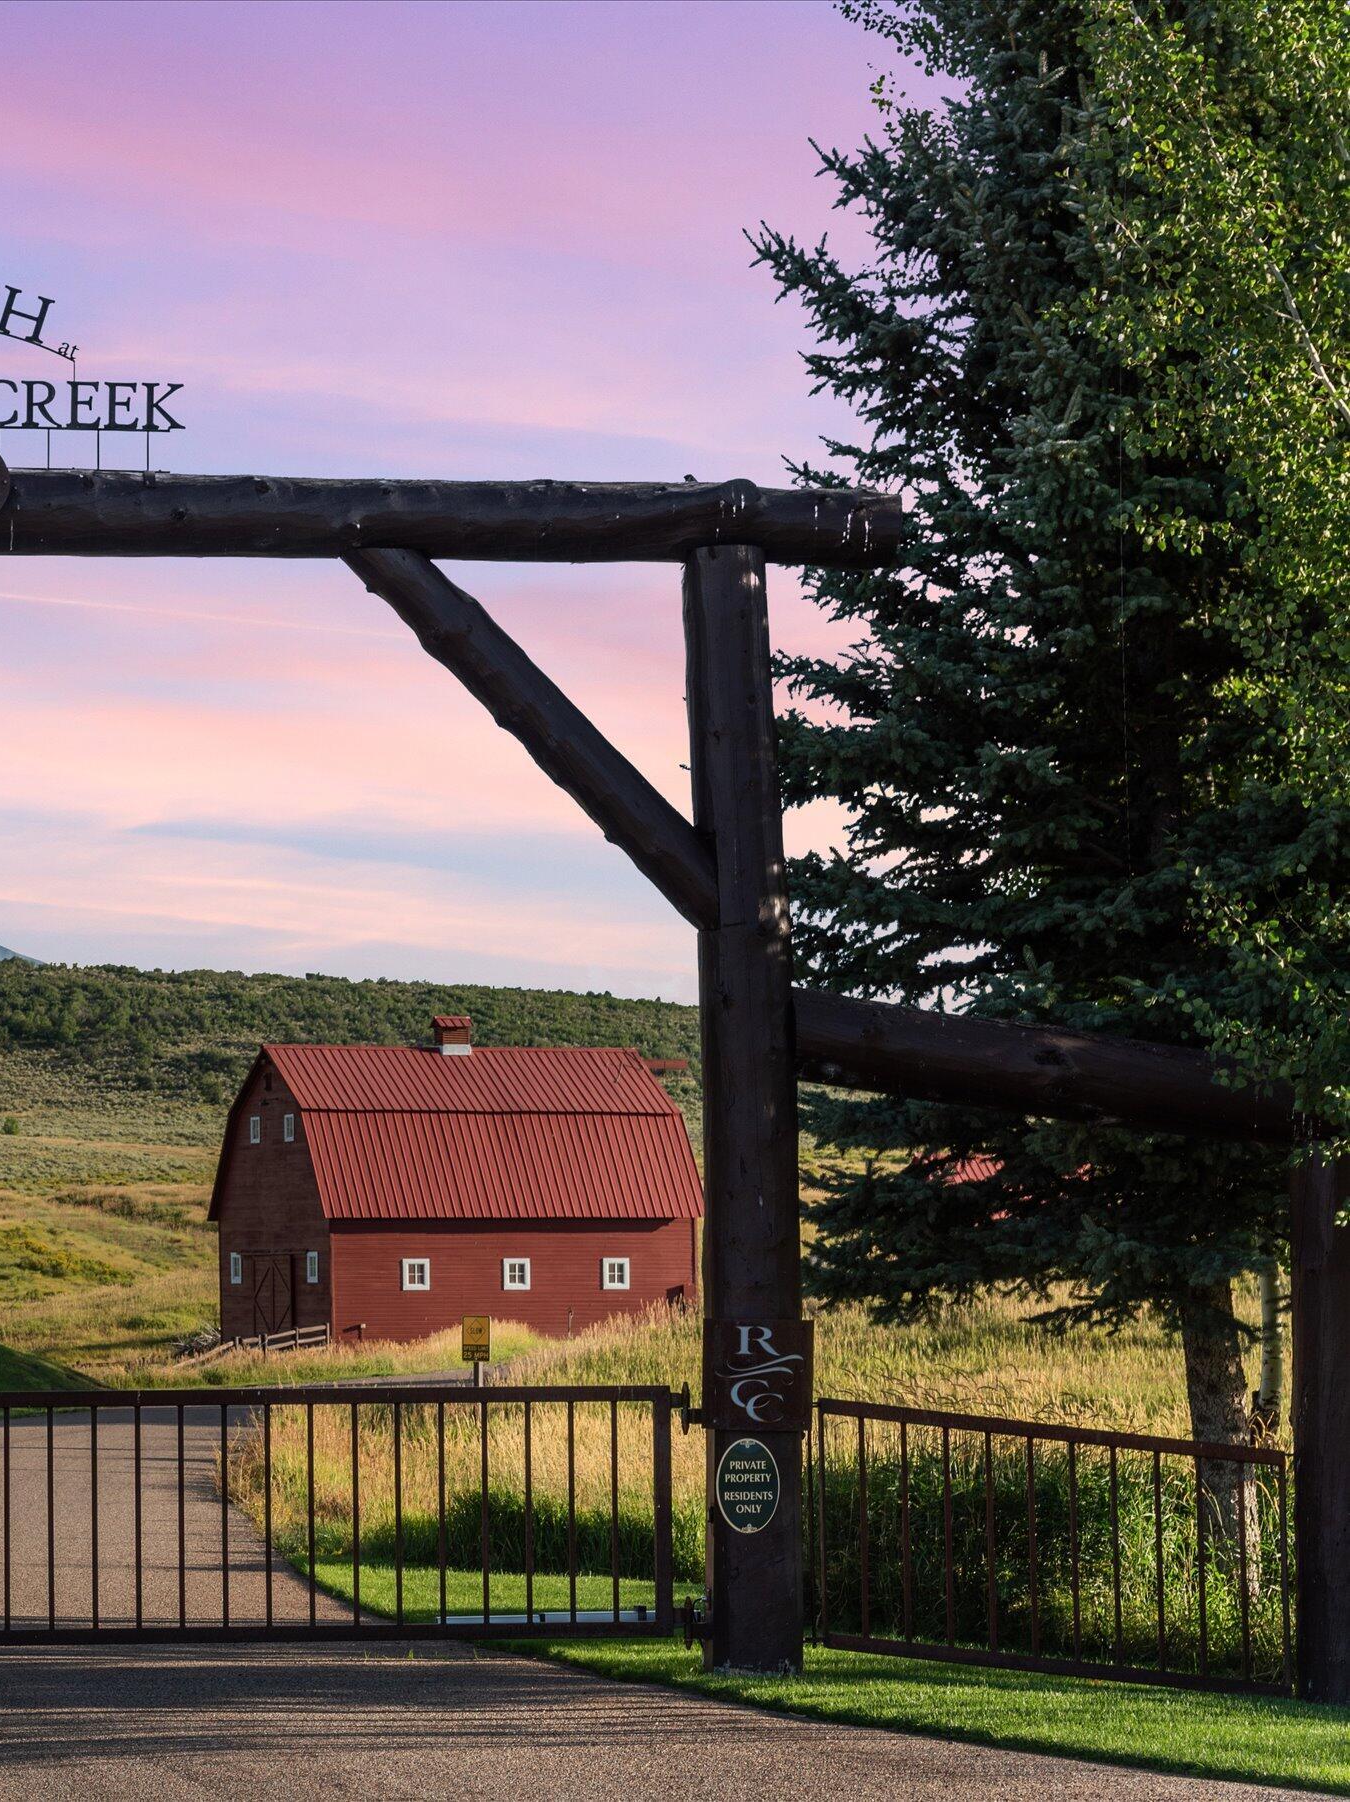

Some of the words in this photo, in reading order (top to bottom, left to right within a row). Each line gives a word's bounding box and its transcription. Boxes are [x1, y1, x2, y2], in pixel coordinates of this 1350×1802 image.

[57, 338, 81, 362] at
[735, 1325, 781, 1357] R
[730, 1460, 767, 1470] PRIVATE
[724, 1473, 772, 1483] PROPERTY
[724, 1491, 773, 1501] RESIDENTS
[735, 1504, 762, 1514] ONLY
